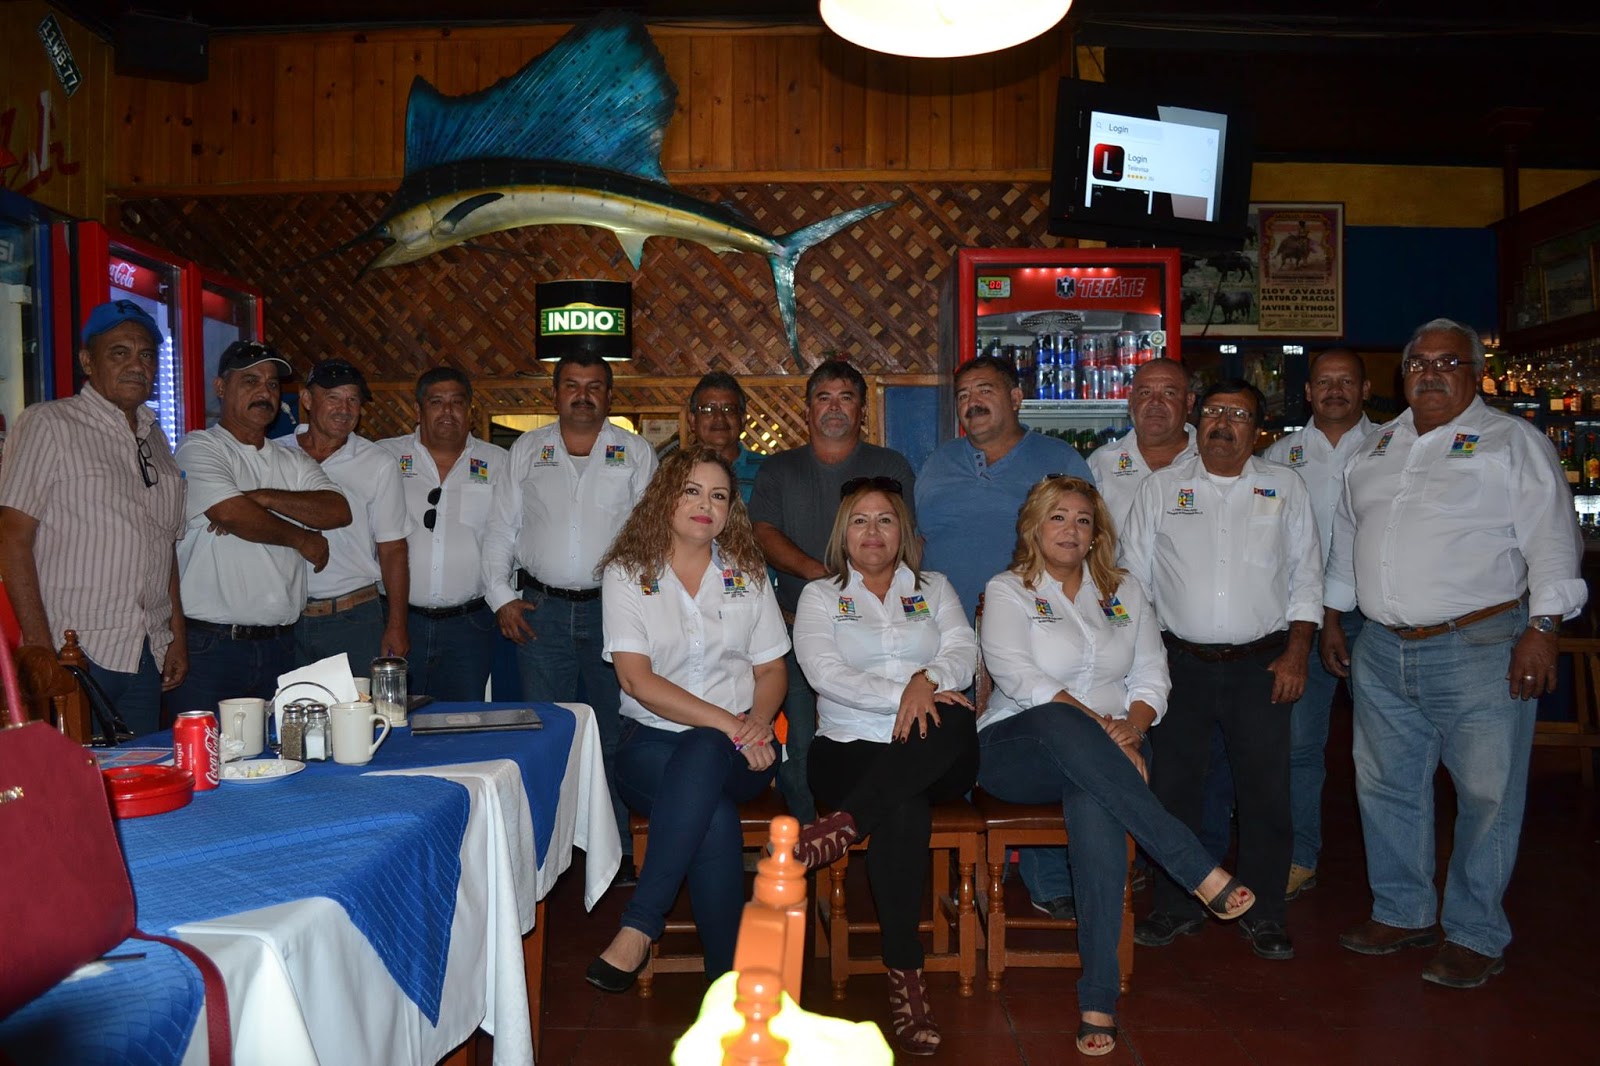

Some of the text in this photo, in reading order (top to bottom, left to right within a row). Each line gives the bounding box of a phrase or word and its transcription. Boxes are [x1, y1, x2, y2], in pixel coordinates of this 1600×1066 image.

[1109, 123, 1129, 134] Login
[1102, 151, 1113, 174] L
[1128, 153, 1148, 163] Login
[1077, 276, 1147, 298] TECATE
[548, 310, 614, 332] INDIO
[175, 742, 184, 769] Angel
[205, 724, 219, 786] Coca-Cola
